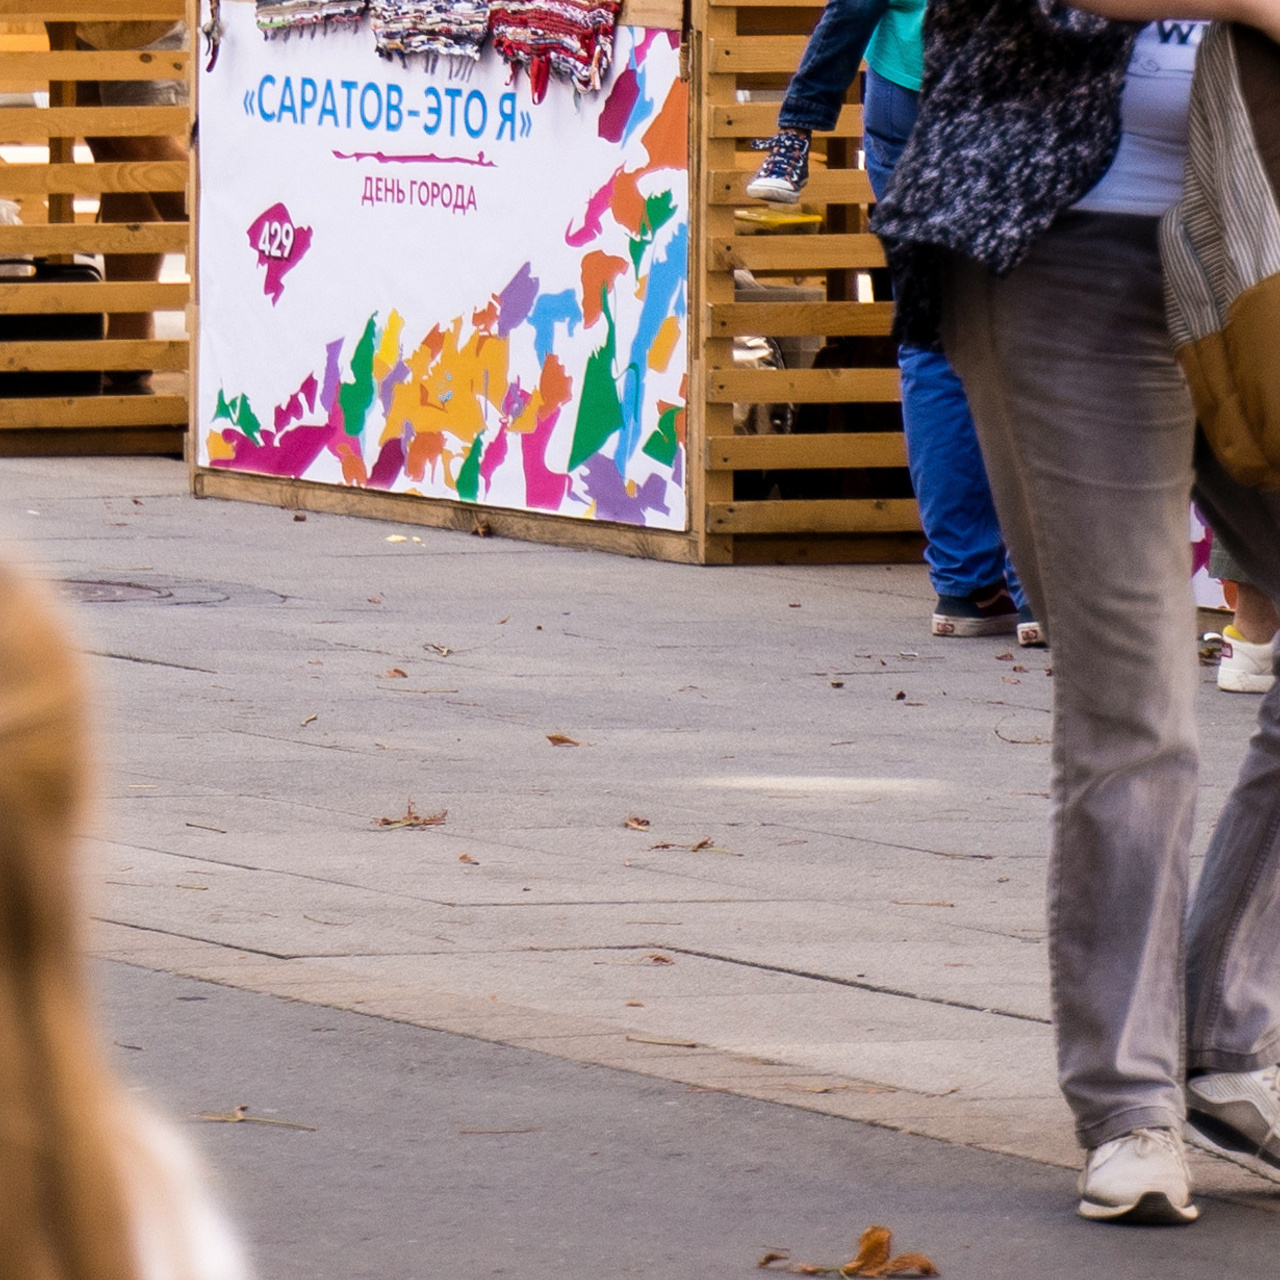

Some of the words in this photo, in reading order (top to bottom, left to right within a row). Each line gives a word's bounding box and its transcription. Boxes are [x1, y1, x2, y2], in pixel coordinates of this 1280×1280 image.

[243, 74, 488, 138] «САРАТОВ-ЭТО
[496, 91, 532, 141] Я»
[362, 176, 405, 206] ДЕНЬ
[410, 179, 477, 214] ГОРОДА
[257, 221, 295, 258] 429
